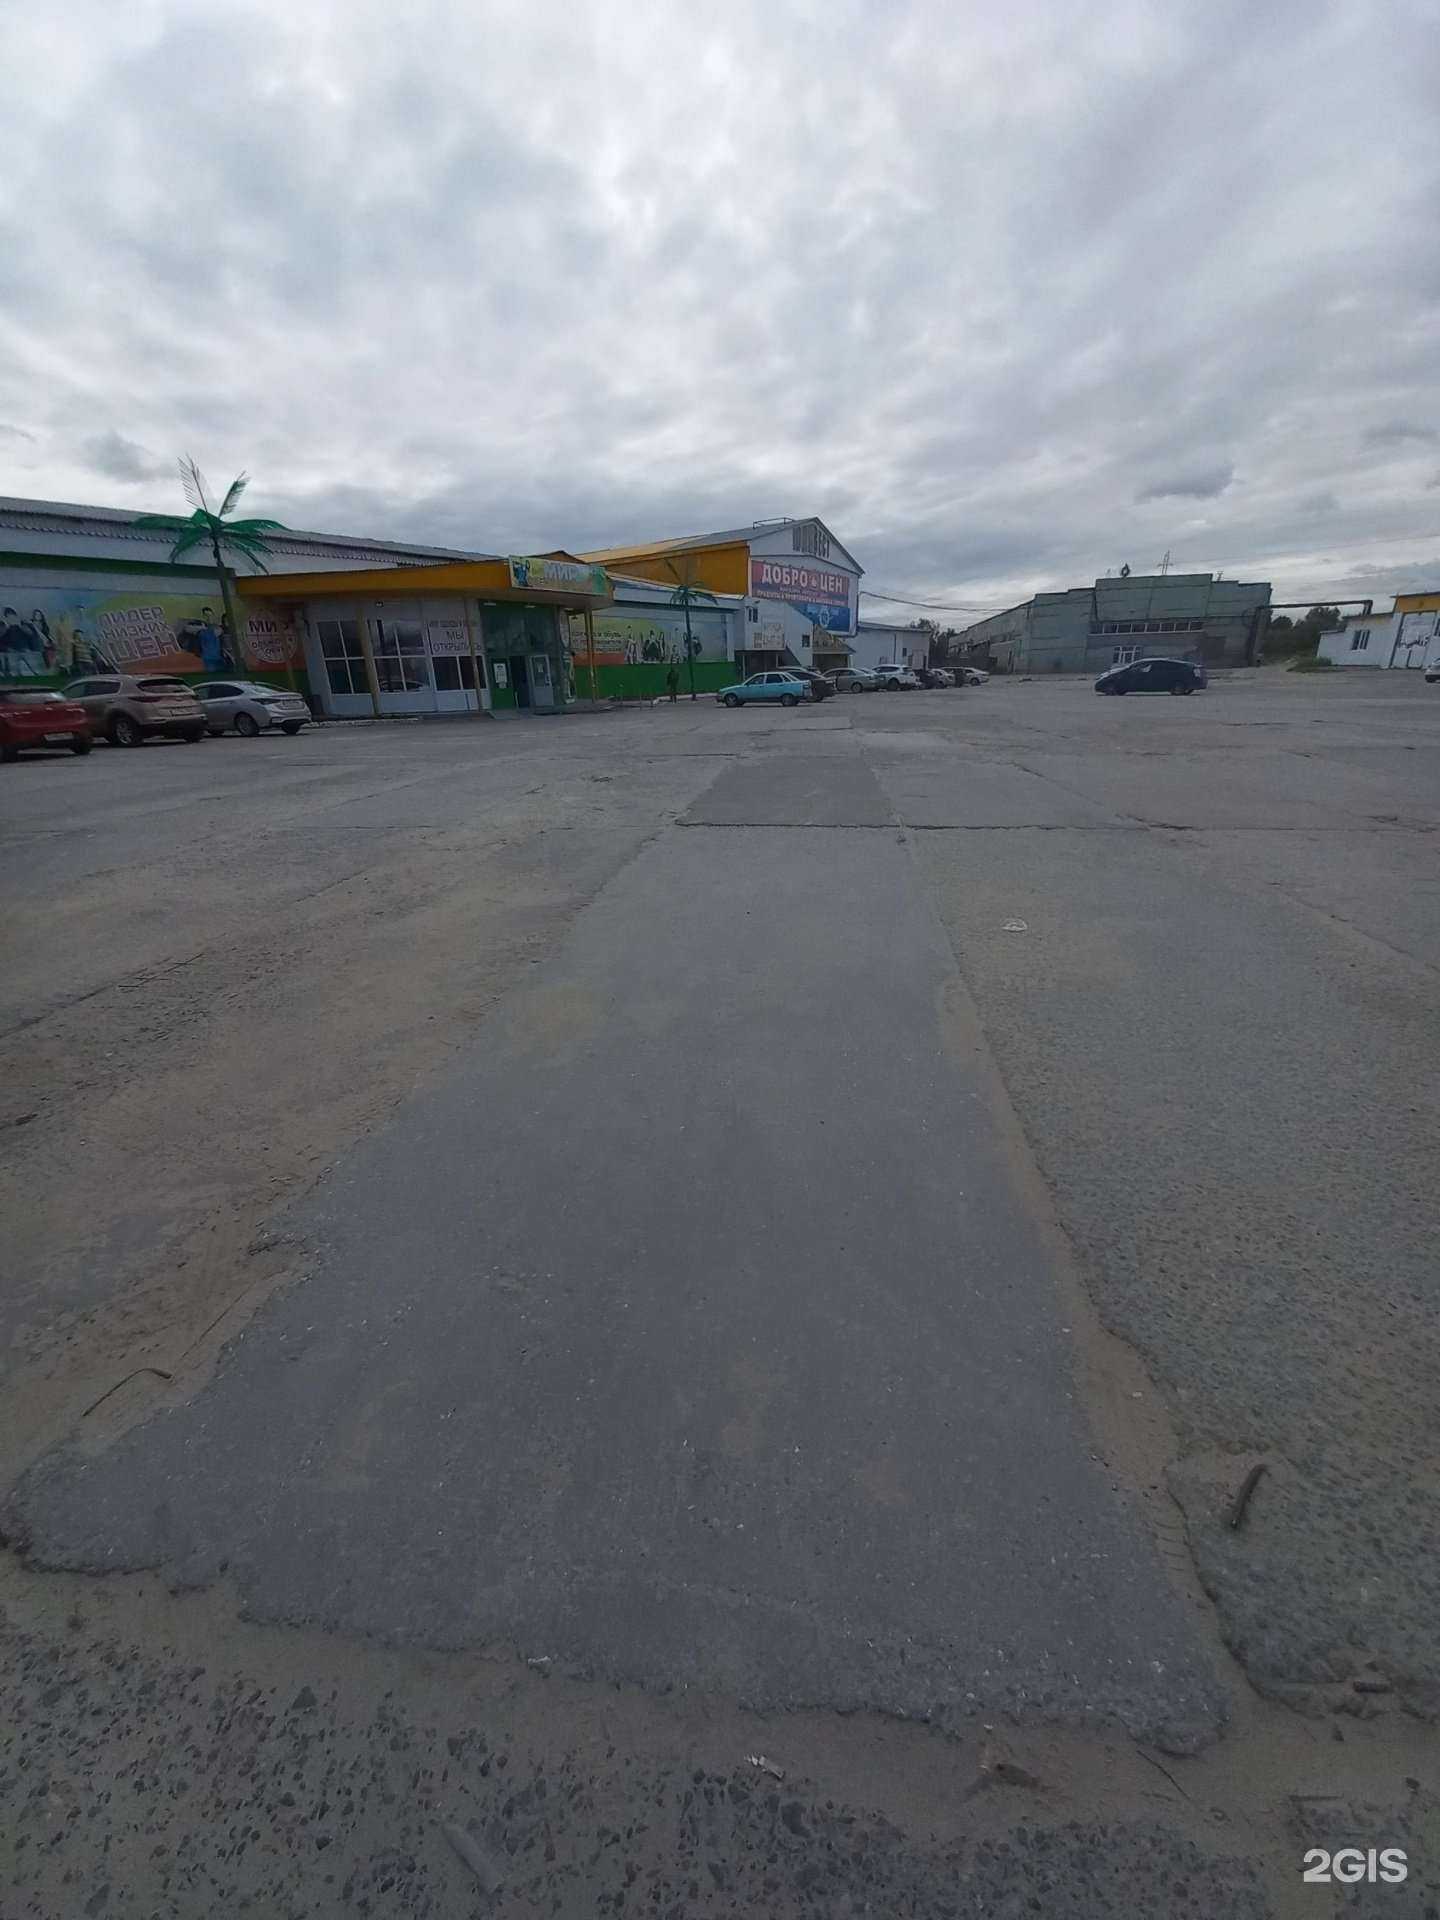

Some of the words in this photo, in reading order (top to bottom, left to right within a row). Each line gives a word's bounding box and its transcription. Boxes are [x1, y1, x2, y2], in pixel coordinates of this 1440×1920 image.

[761, 564, 808, 587] ДОБРО
[820, 574, 843, 593] ЦЕН
[98, 607, 165, 625] ЛИДЕР
[102, 622, 169, 639] НИЗКИХ
[106, 632, 178, 663] ЦЕН
